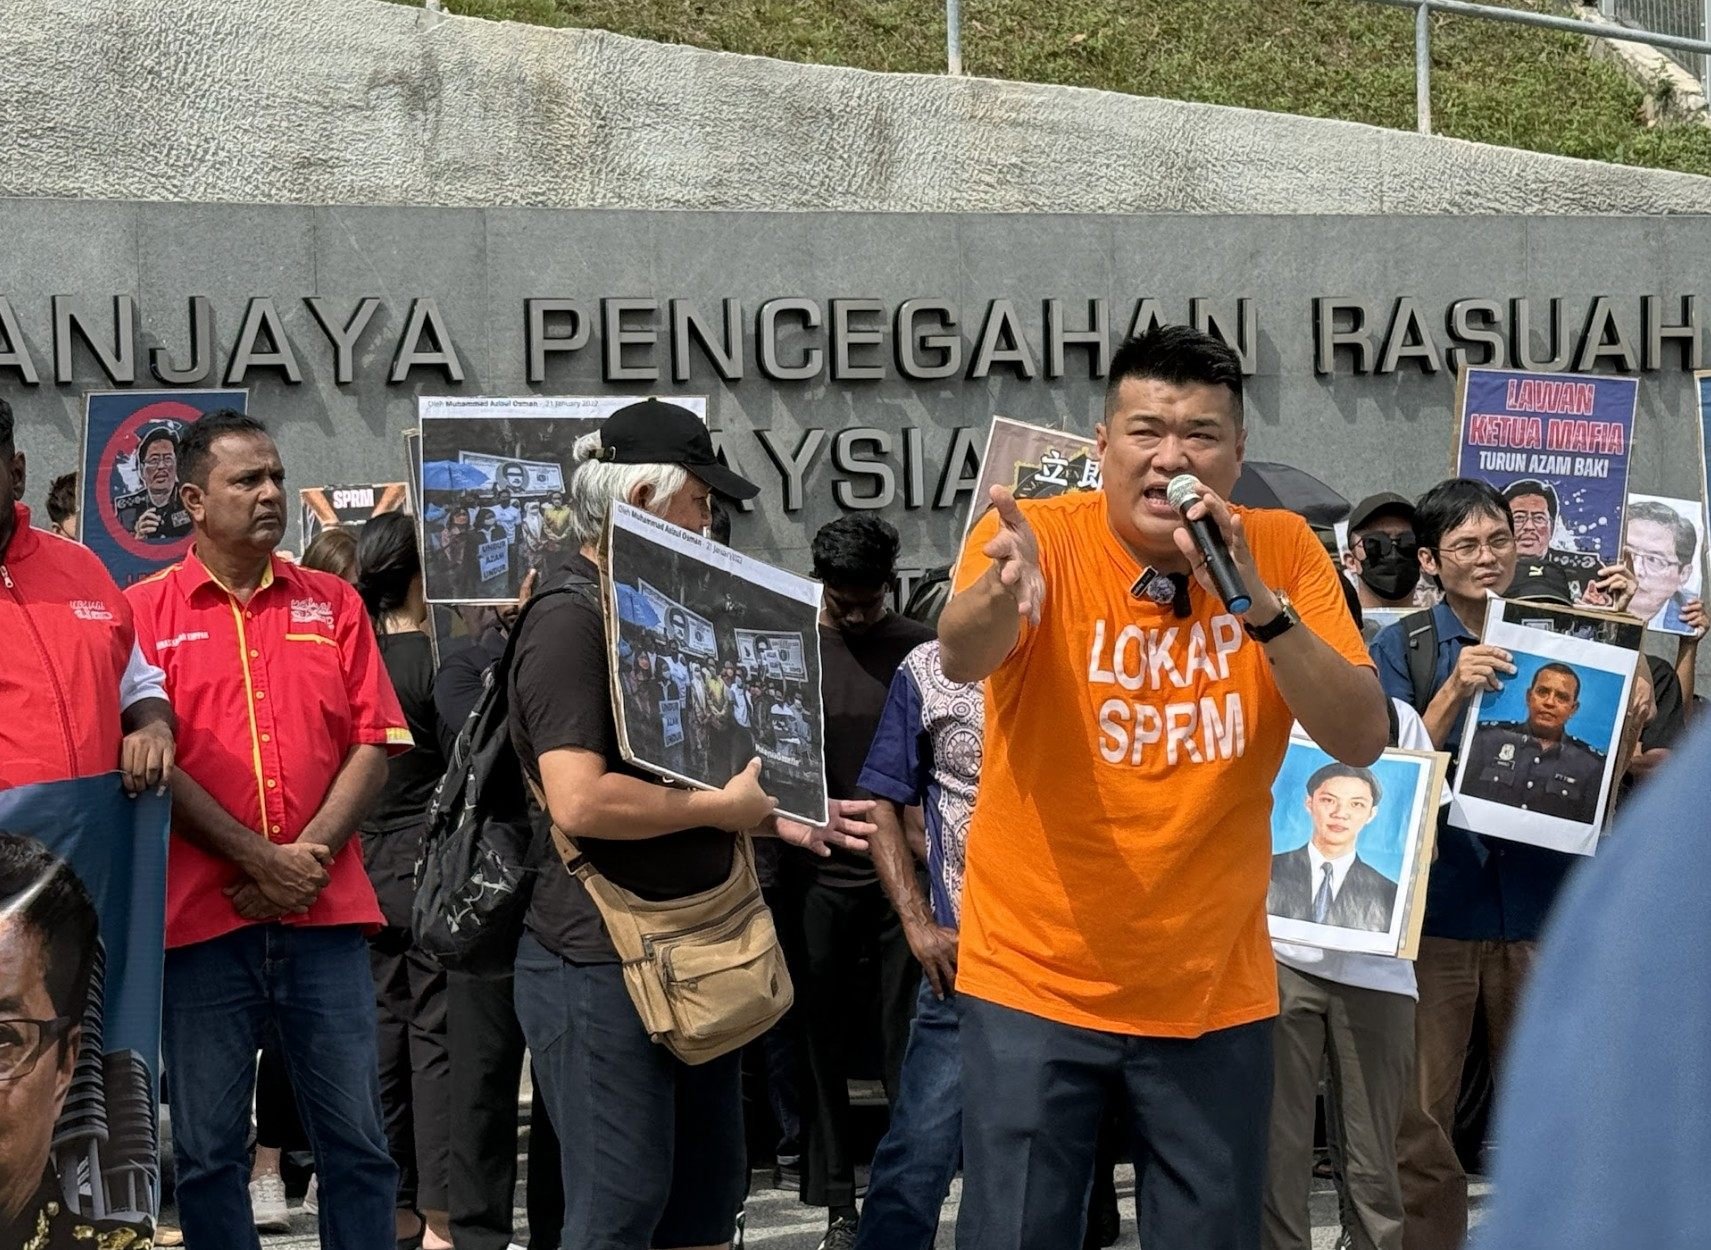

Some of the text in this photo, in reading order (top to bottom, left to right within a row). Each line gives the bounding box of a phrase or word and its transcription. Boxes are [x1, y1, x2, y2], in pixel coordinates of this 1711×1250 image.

[1313, 295, 1702, 375] RASUAH
[1506, 379, 1595, 416] LAWAN
[1469, 414, 1624, 455] KETUA MAFIA
[1479, 451, 1609, 478] TURUN AZAM BAKI
[333, 488, 375, 509] SPRM
[1088, 614, 1243, 690] LOKAP
[1099, 693, 1245, 766] SPRM
